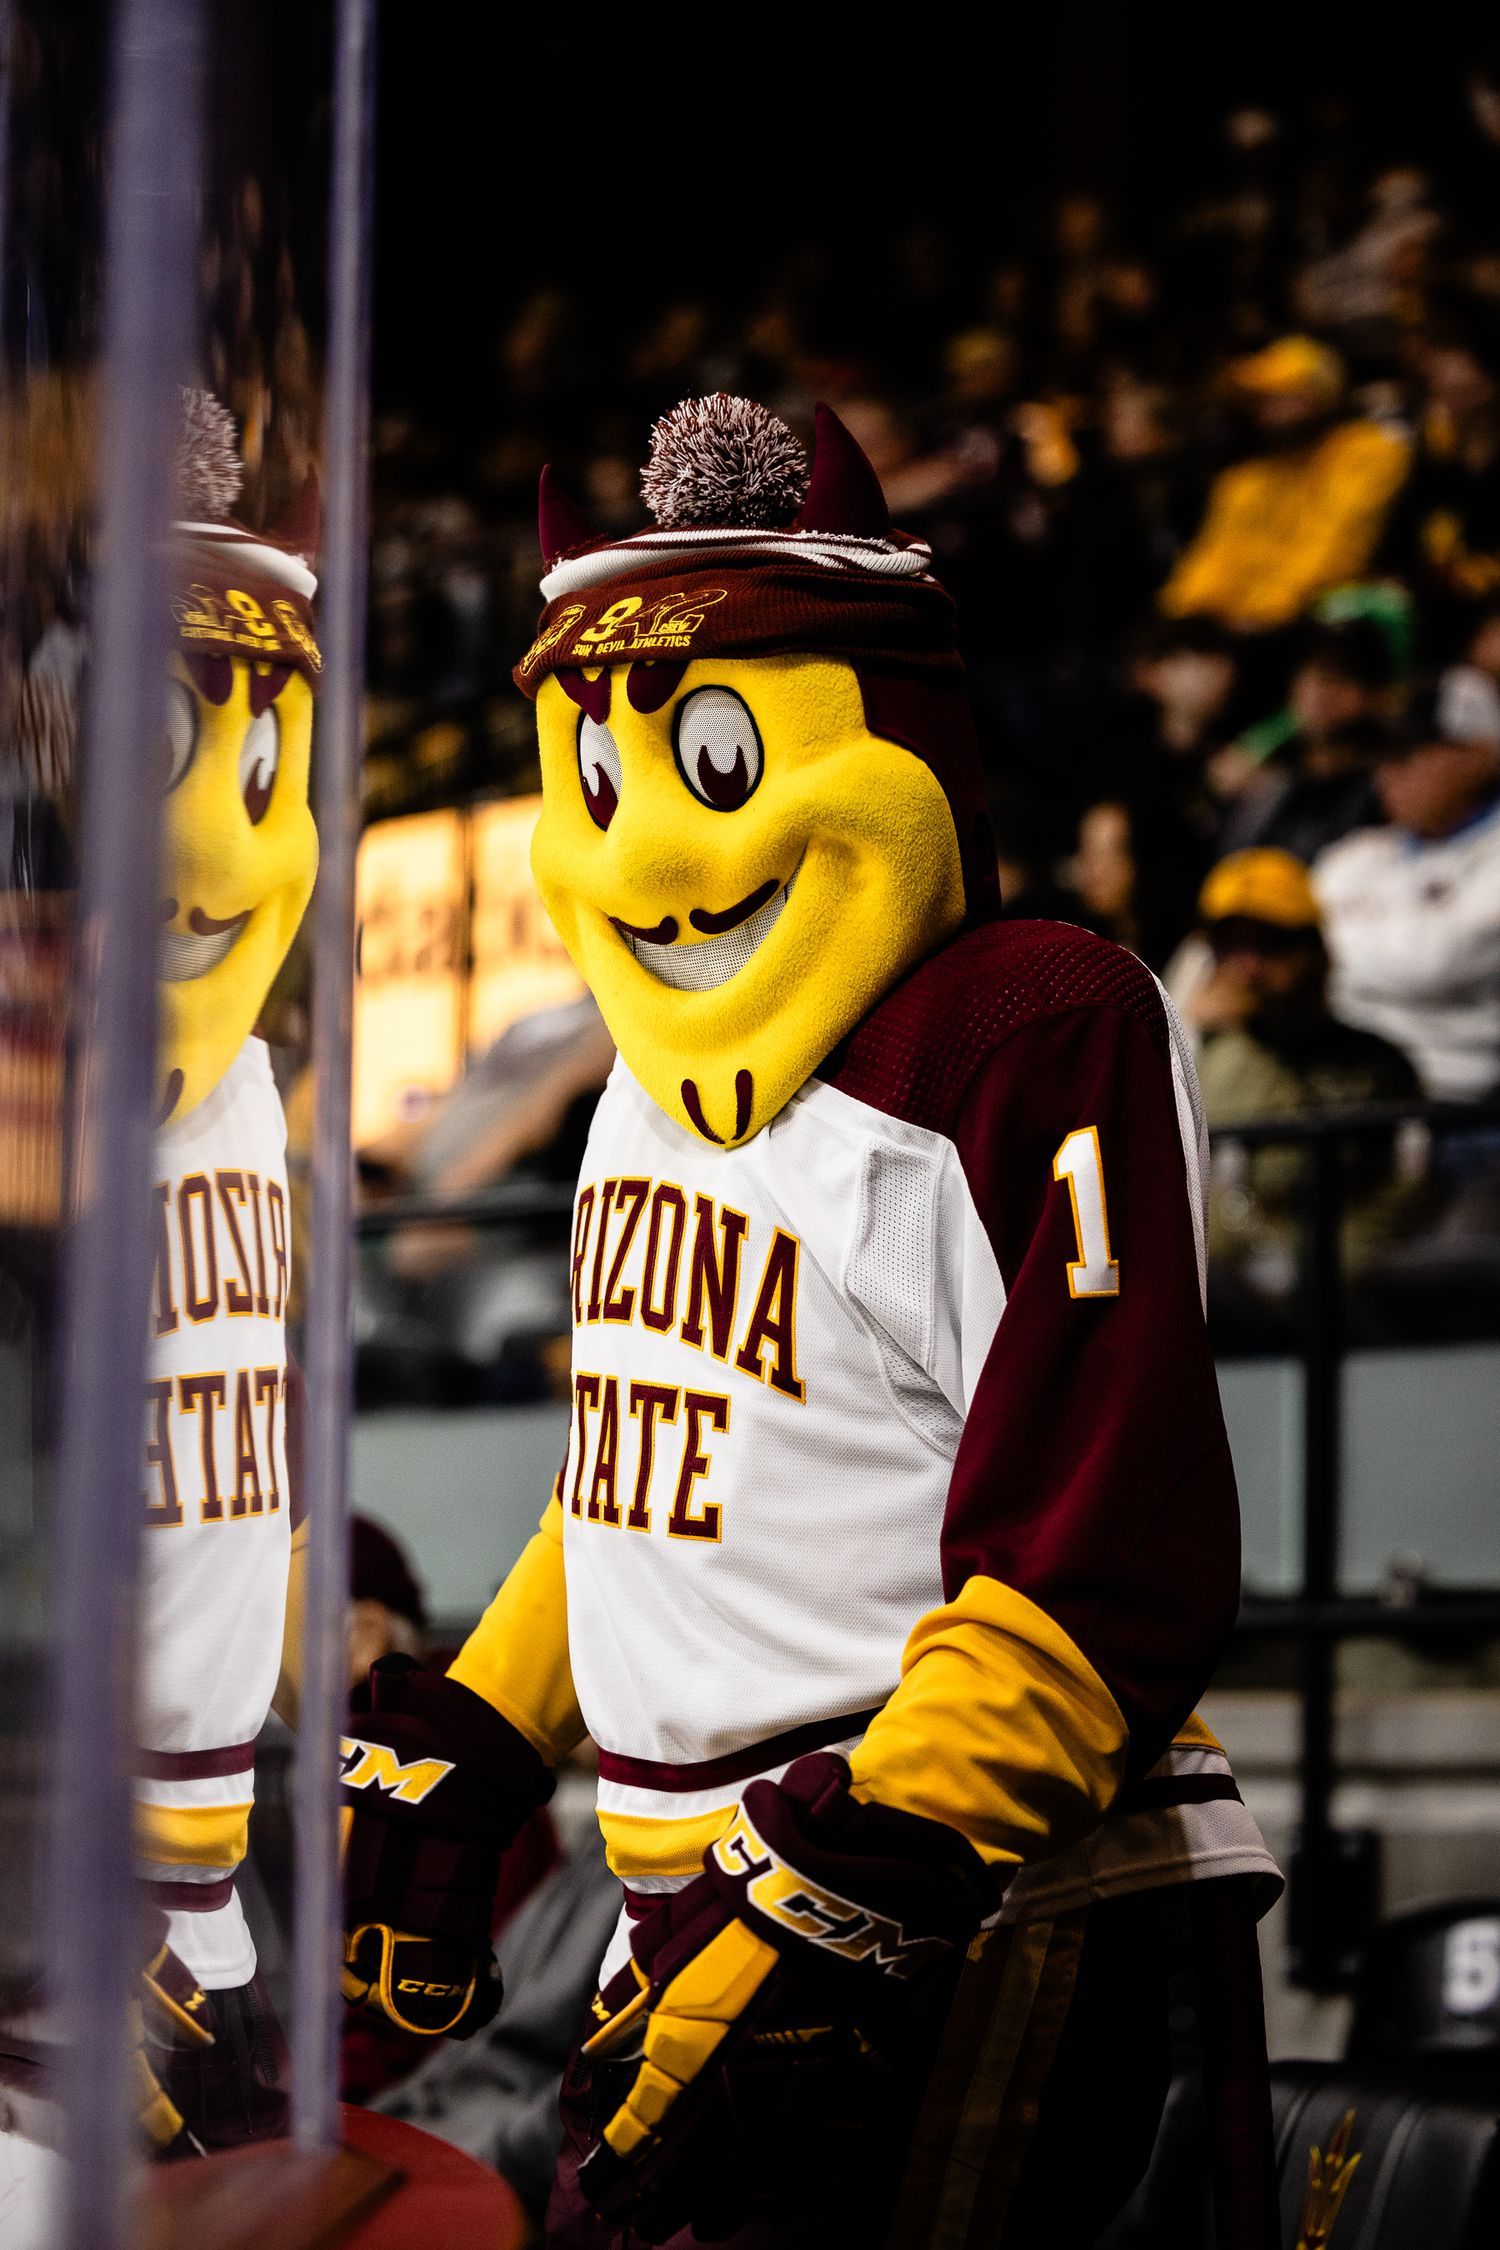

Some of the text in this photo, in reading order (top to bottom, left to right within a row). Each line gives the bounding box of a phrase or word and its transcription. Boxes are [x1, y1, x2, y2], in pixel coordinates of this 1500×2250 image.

[595, 639, 626, 655] DEVIL
[630, 635, 691, 649] ATHLETICS
[570, 1176, 806, 1405] RIZONA
[1053, 1125, 1120, 1299] 1
[570, 1371, 732, 1543] TATE
[712, 1801, 954, 1981] CCM
